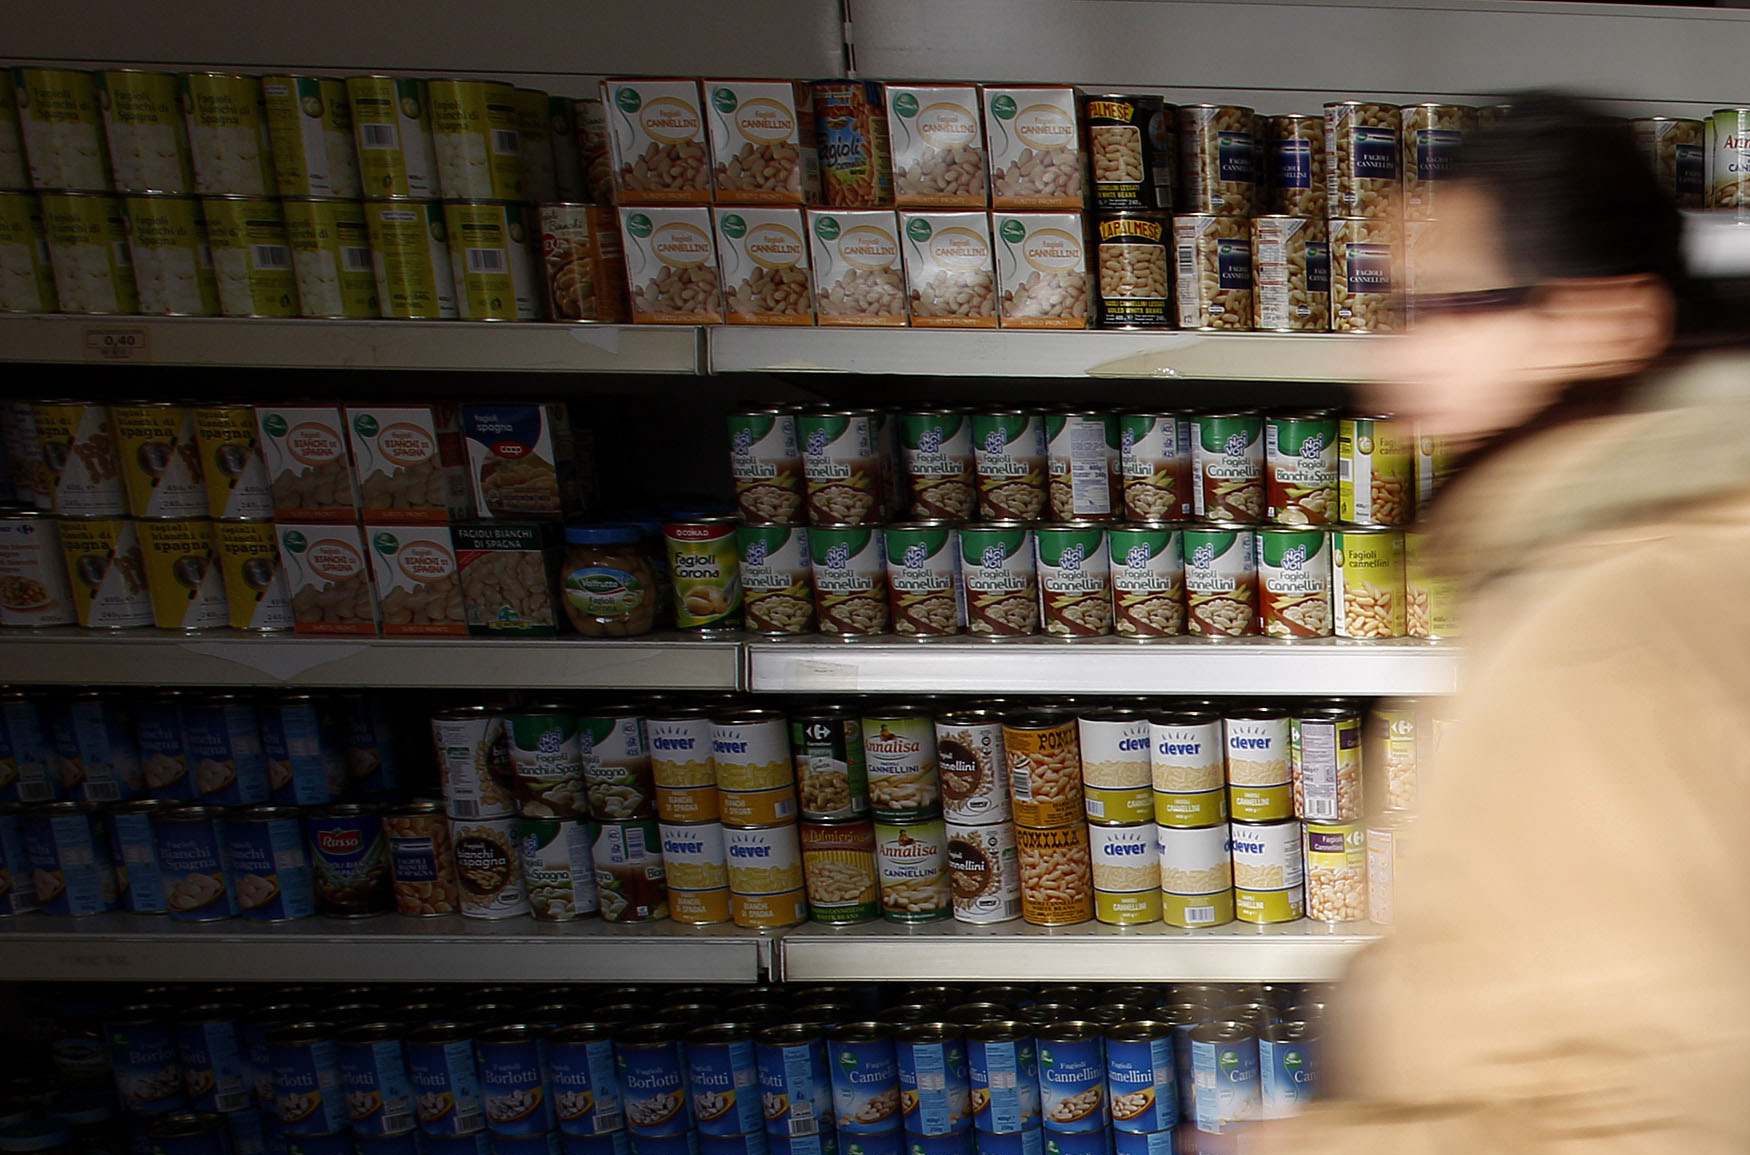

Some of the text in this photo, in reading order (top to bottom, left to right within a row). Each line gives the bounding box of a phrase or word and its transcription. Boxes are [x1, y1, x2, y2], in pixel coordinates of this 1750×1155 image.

[647, 119, 697, 129] CANNELLINI
[741, 119, 791, 130] CANNELLINI
[923, 124, 976, 134] CANNELLINI
[1021, 126, 1072, 135] CANNELLINI
[657, 244, 708, 253] CANNELLINI
[751, 245, 800, 254] CANNELLINI
[844, 245, 895, 256] CANNELLINI
[935, 248, 987, 257] CANNELLINI
[1029, 249, 1080, 258] CANNELLINI
[104, 336, 136, 347] 0,40
[917, 454, 946, 463] Fagioli
[1222, 457, 1250, 467] Fagioli
[1297, 460, 1326, 470] Fagioli
[1277, 470, 1309, 481] Bianchi
[494, 529, 534, 539] BIANCHI
[1349, 550, 1377, 560] Fagioli
[1349, 559, 1391, 568] cannellini
[674, 568, 720, 579] Corona
[824, 570, 853, 579] Fagioli
[903, 570, 932, 579] Fagioli
[980, 570, 1010, 580] Fagioli
[1058, 571, 1088, 580] Fagioli
[1125, 570, 1153, 580] Fagioli
[1280, 571, 1309, 582] Fagioli
[894, 577, 949, 589] Cannellini
[969, 578, 1025, 589] Cannellini
[1046, 579, 1101, 591] Cannellini
[1116, 578, 1170, 589] Cannellini
[1268, 579, 1322, 591] Cannellini
[654, 737, 695, 750] clever
[865, 740, 920, 753] Annalisa
[1159, 741, 1201, 755] clever
[1230, 736, 1271, 749] clever
[590, 768, 625, 778] Spagna
[665, 840, 702, 853] clever
[730, 845, 771, 857] clever
[880, 845, 937, 856] Annalisa
[1104, 841, 1146, 855] clever
[533, 871, 568, 881] Spagna
[884, 868, 936, 877] CANNELLINI
[485, 1069, 537, 1085] Borlotti
[627, 1073, 680, 1089] Borlotti
[1046, 1069, 1100, 1084] Cannellini
